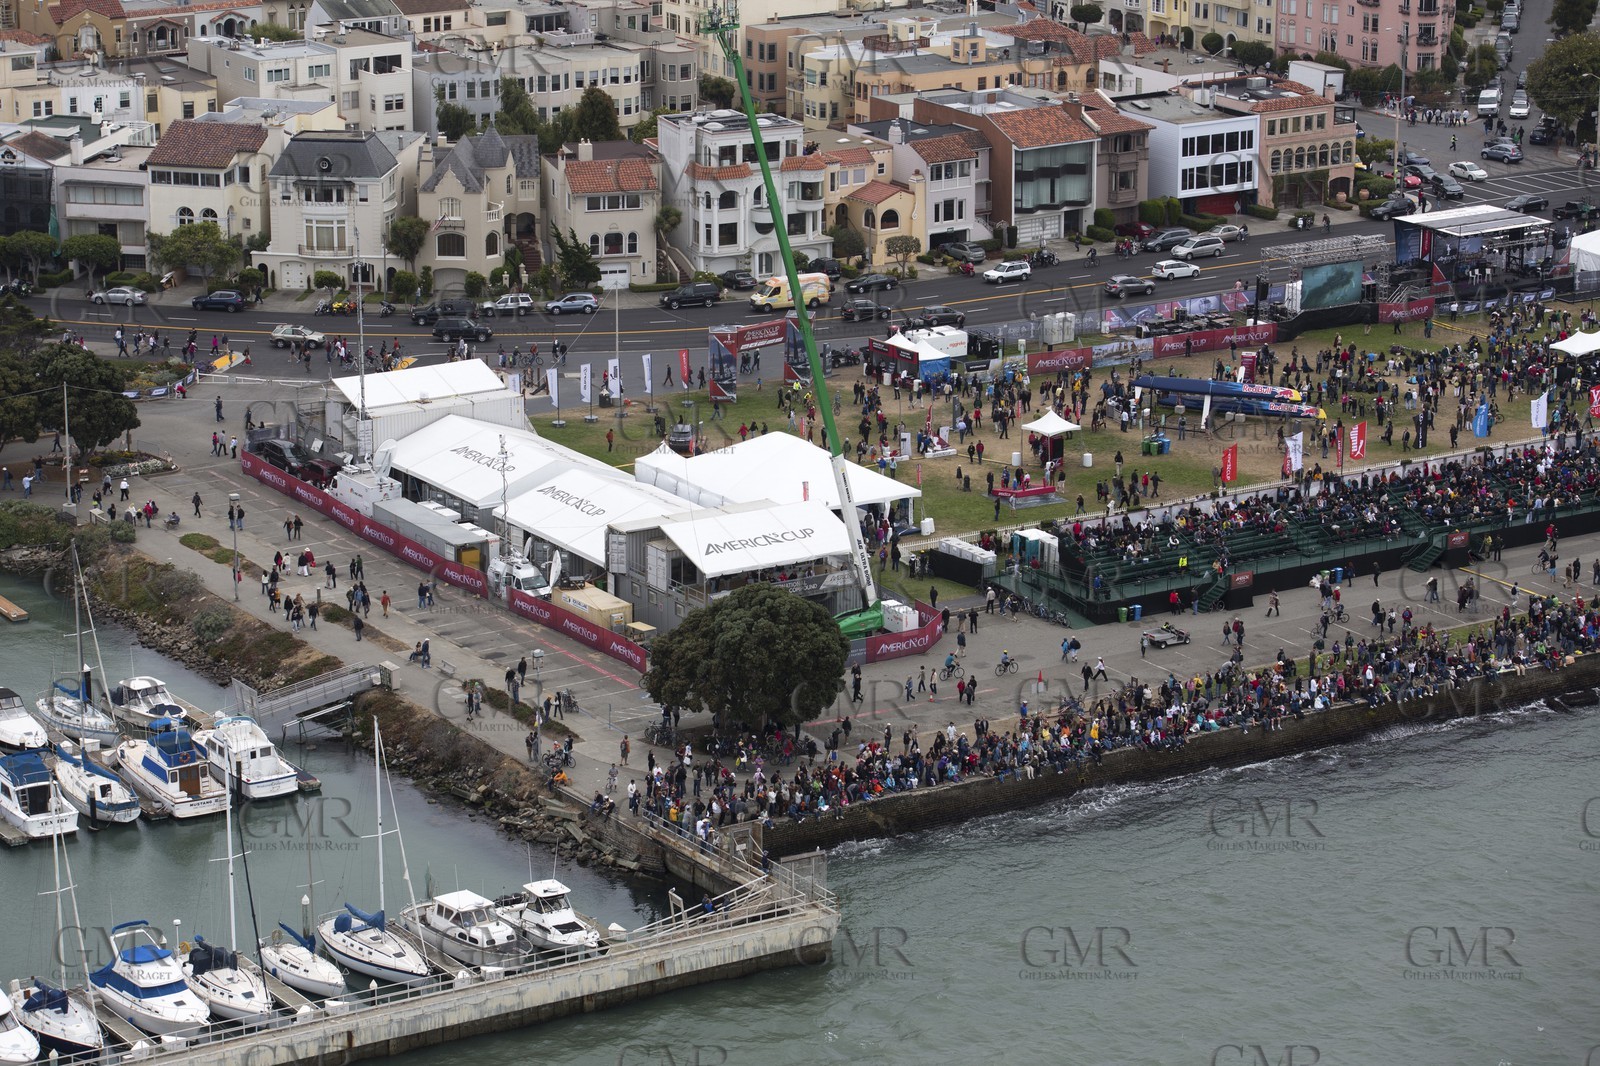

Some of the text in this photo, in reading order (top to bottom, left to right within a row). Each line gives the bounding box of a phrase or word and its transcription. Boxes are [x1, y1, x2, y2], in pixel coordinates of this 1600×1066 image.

[1242, 384, 1273, 394] Red Bull
[581, 501, 606, 518] CUP
[780, 528, 815, 542] CUP
[917, 635, 929, 646] CUP
